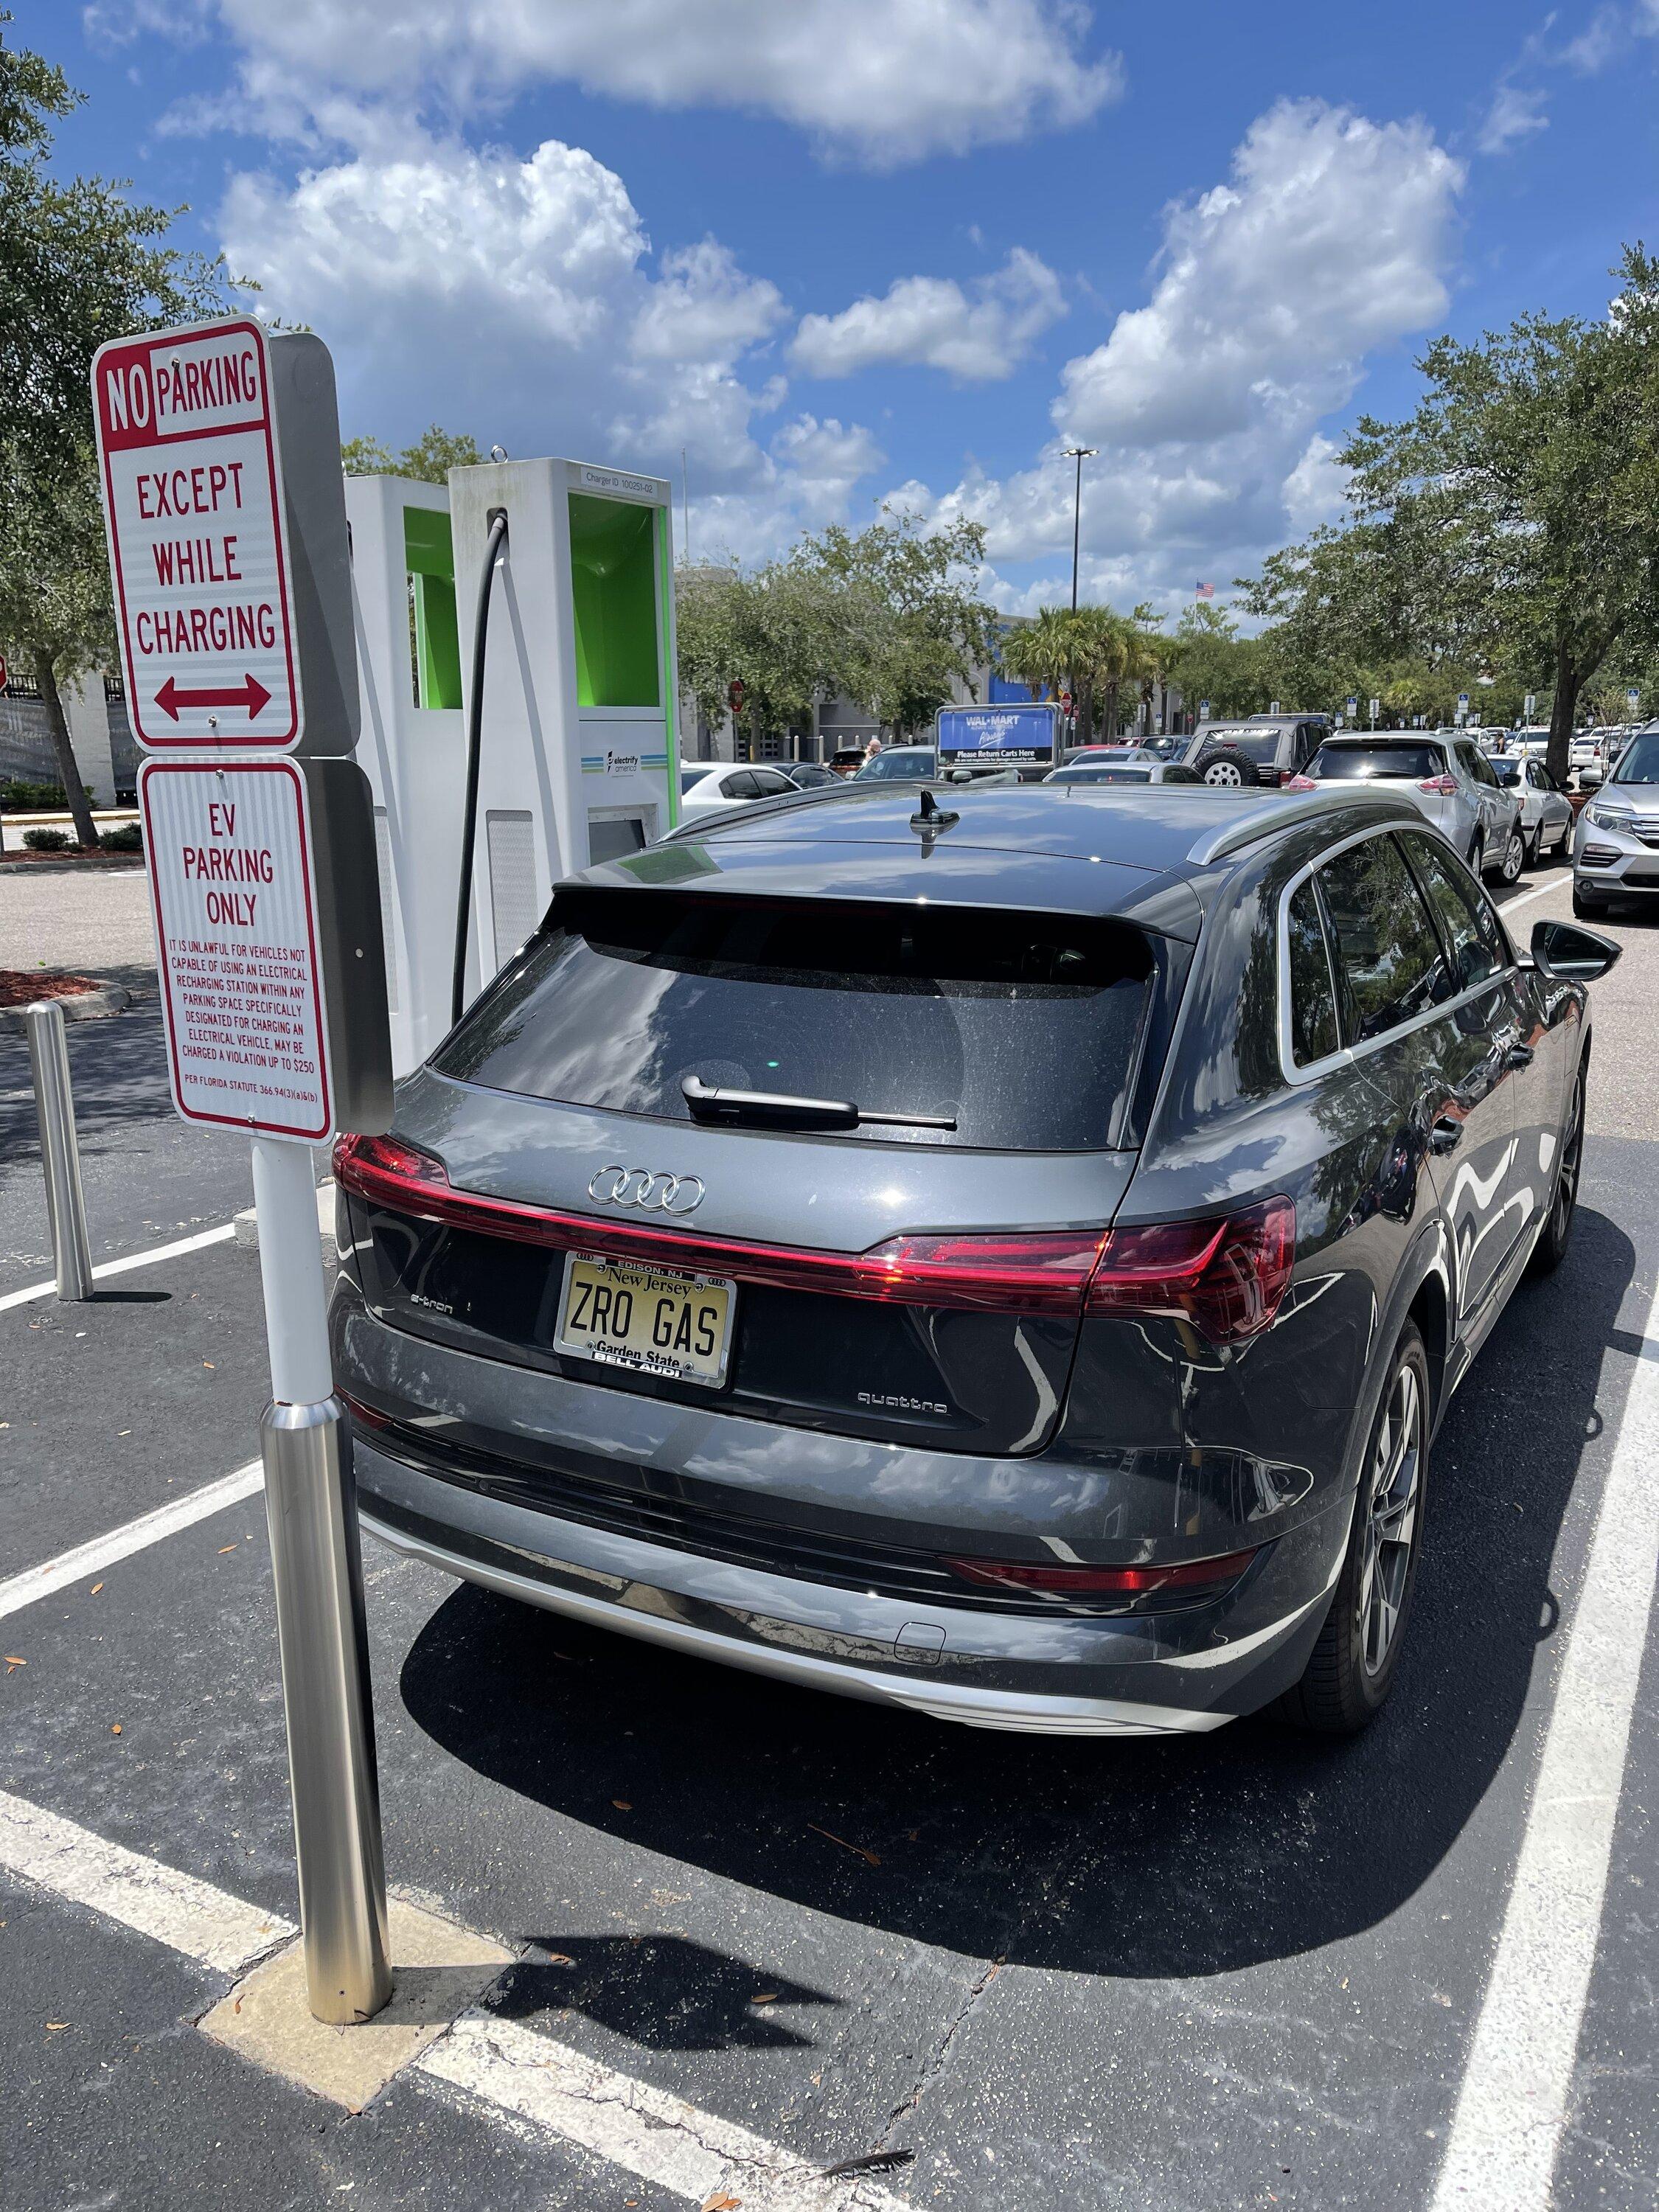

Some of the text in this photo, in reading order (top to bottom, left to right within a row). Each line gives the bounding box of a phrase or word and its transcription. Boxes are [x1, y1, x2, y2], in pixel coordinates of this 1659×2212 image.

[106, 351, 256, 431] NO PARKING
[136, 462, 243, 519] EXCEPT
[586, 473, 653, 493] Charger ID 100251-02
[153, 536, 242, 585] WHILE
[137, 603, 275, 655] CHARGING
[614, 757, 638, 765] electrify
[978, 750, 1000, 758] Return
[209, 804, 235, 837] EV
[183, 847, 273, 883] PARKING
[207, 891, 257, 926] ONLY
[170, 939, 305, 961] IT IS UNLAWFUL FOR VEHICLES NOT
[172, 957, 307, 981] CAPABLE OF USING AN ELECTRICAL
[177, 975, 305, 999] RECHARGING STATION WITHIN ANY
[184, 993, 301, 1017] PARKING SPACE SPECIFICALLY
[186, 1011, 303, 1035] DESIGNATED FOR CHARGING AN
[189, 1029, 304, 1054] ELECTRICAL VEHICLE, MAY BE
[183, 1045, 314, 1073] CHARGED A VIOLATION UP TO $250
[185, 1074, 198, 1084] PER
[200, 1077, 227, 1088] FLORIDA
[230, 1080, 257, 1093] STATUTE
[608, 1267, 692, 1299] New Jersey
[668, 1269, 683, 1279] NJ
[411, 1294, 453, 1314] e-tron
[653, 1298, 717, 1357] GAS
[594, 1352, 680, 1378] BELL AUDI
[597, 1340, 680, 1368] Garden State
[858, 1392, 947, 1413] quattro
